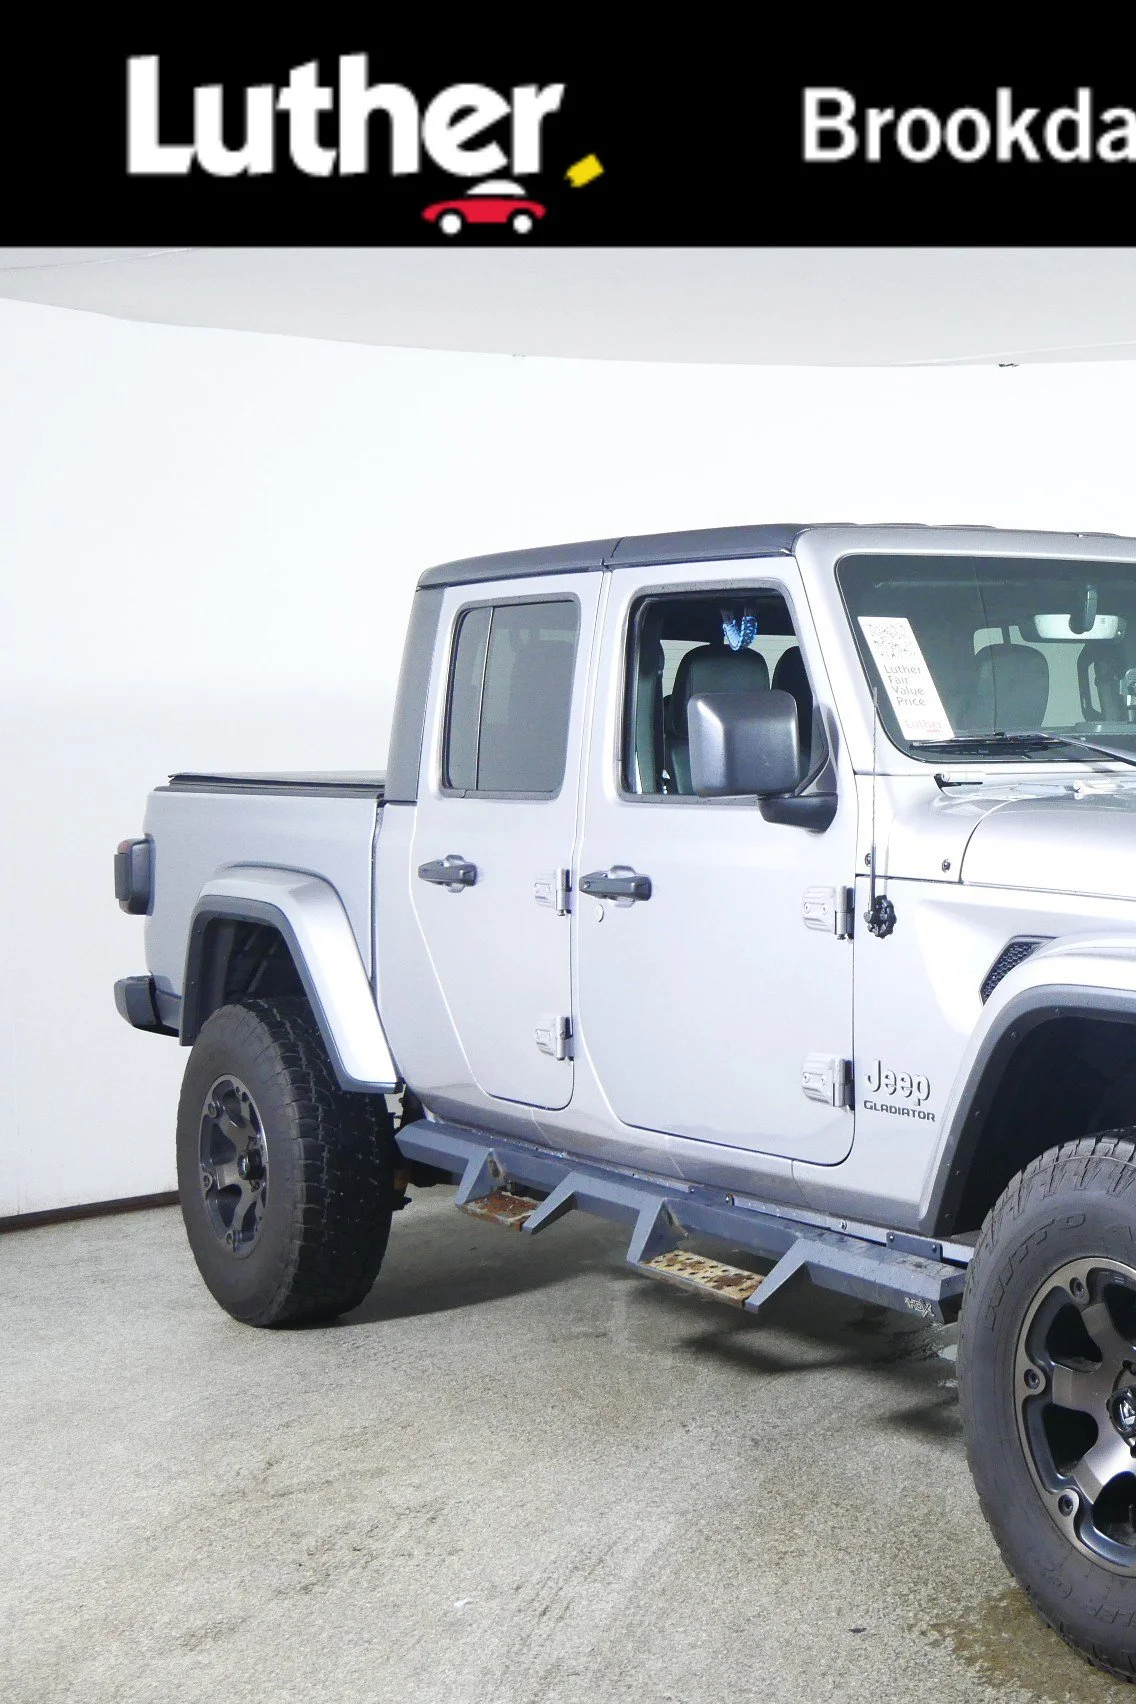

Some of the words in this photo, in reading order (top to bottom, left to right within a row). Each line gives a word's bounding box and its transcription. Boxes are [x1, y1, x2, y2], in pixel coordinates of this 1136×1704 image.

[884, 664, 921, 675] Luther
[888, 675, 909, 685] Fair
[892, 685, 926, 696] Value
[896, 696, 926, 706] Price
[864, 1058, 931, 1107] Jeep
[863, 1099, 936, 1122] GLADIATOR
